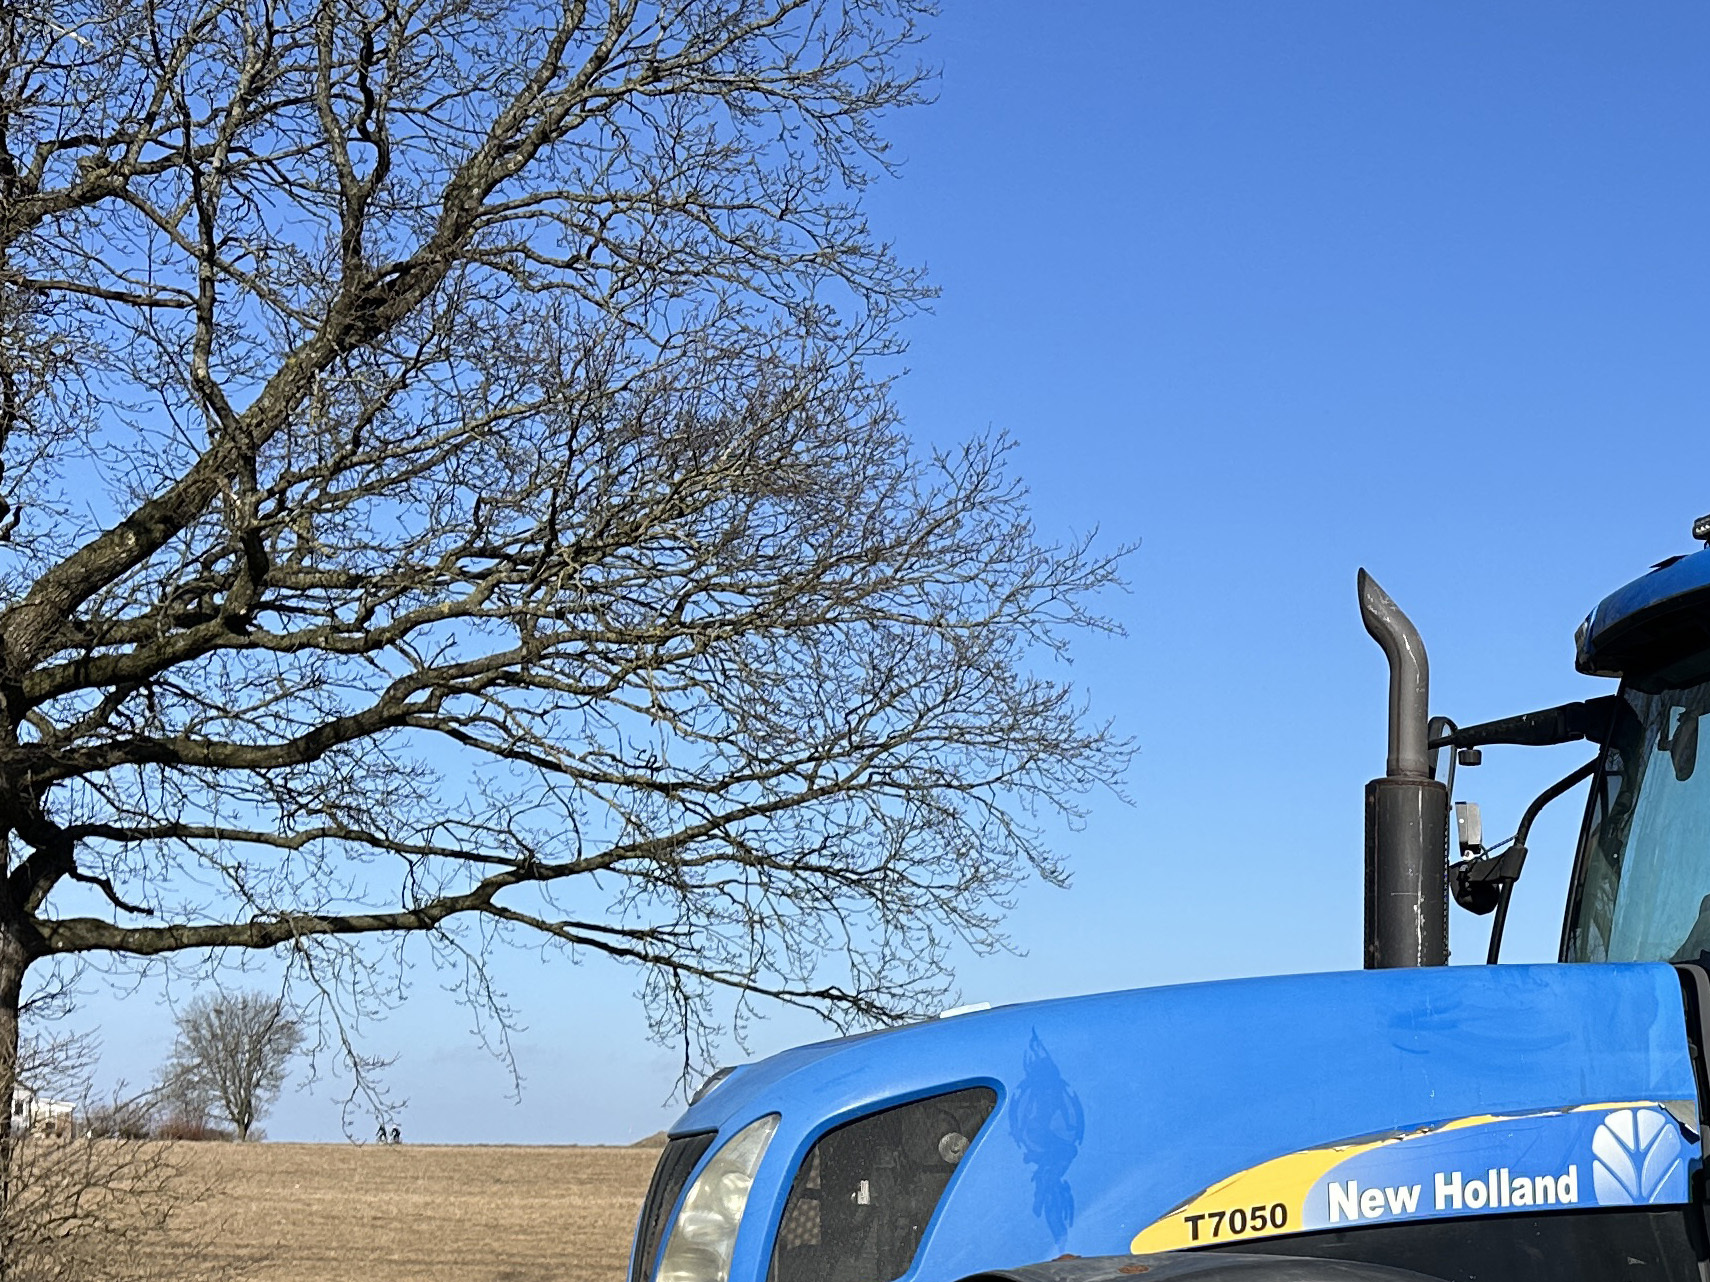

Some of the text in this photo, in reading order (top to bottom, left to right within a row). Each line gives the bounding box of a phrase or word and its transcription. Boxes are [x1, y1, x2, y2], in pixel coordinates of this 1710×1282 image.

[1327, 1165, 1579, 1222] New Holland
[1184, 1202, 1288, 1241] T7050
